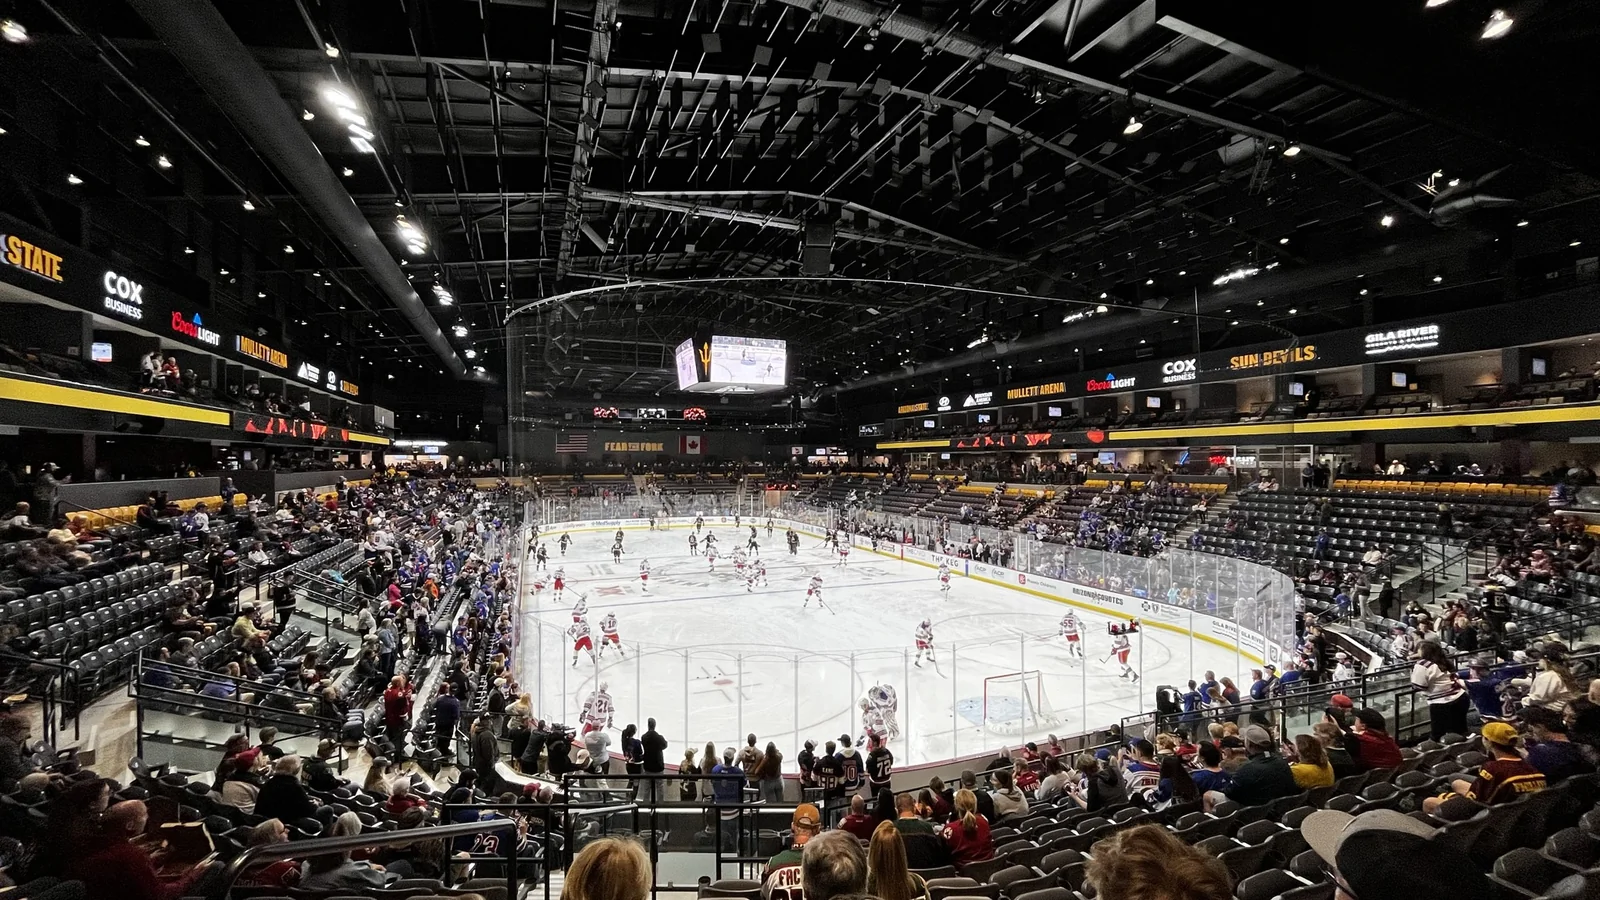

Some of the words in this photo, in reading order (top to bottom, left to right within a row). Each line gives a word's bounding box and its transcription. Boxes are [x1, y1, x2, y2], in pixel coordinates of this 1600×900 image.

[7, 235, 64, 282] STATE
[103, 270, 143, 305] COX
[104, 297, 142, 320] BUSINESS
[172, 311, 198, 338] Coors
[197, 327, 220, 346] LIGHT
[1365, 331, 1396, 343] GILA
[1397, 325, 1439, 339] RIVER
[1162, 358, 1196, 375] COX
[1230, 353, 1259, 370] SUN
[1263, 345, 1317, 366] DEVILS
[1110, 377, 1136, 389] LIGHT
[1162, 372, 1197, 383] BUSINESS
[1007, 386, 1039, 400] MULLETT
[1039, 382, 1066, 395] ARENA
[604, 442, 628, 452] FEAR
[640, 442, 664, 452] FORK
[945, 557, 959, 568] KEG
[1063, 619, 1074, 629] 55
[597, 699, 608, 713] 21
[877, 759, 891, 778] 72
[779, 868, 802, 886] FAC
